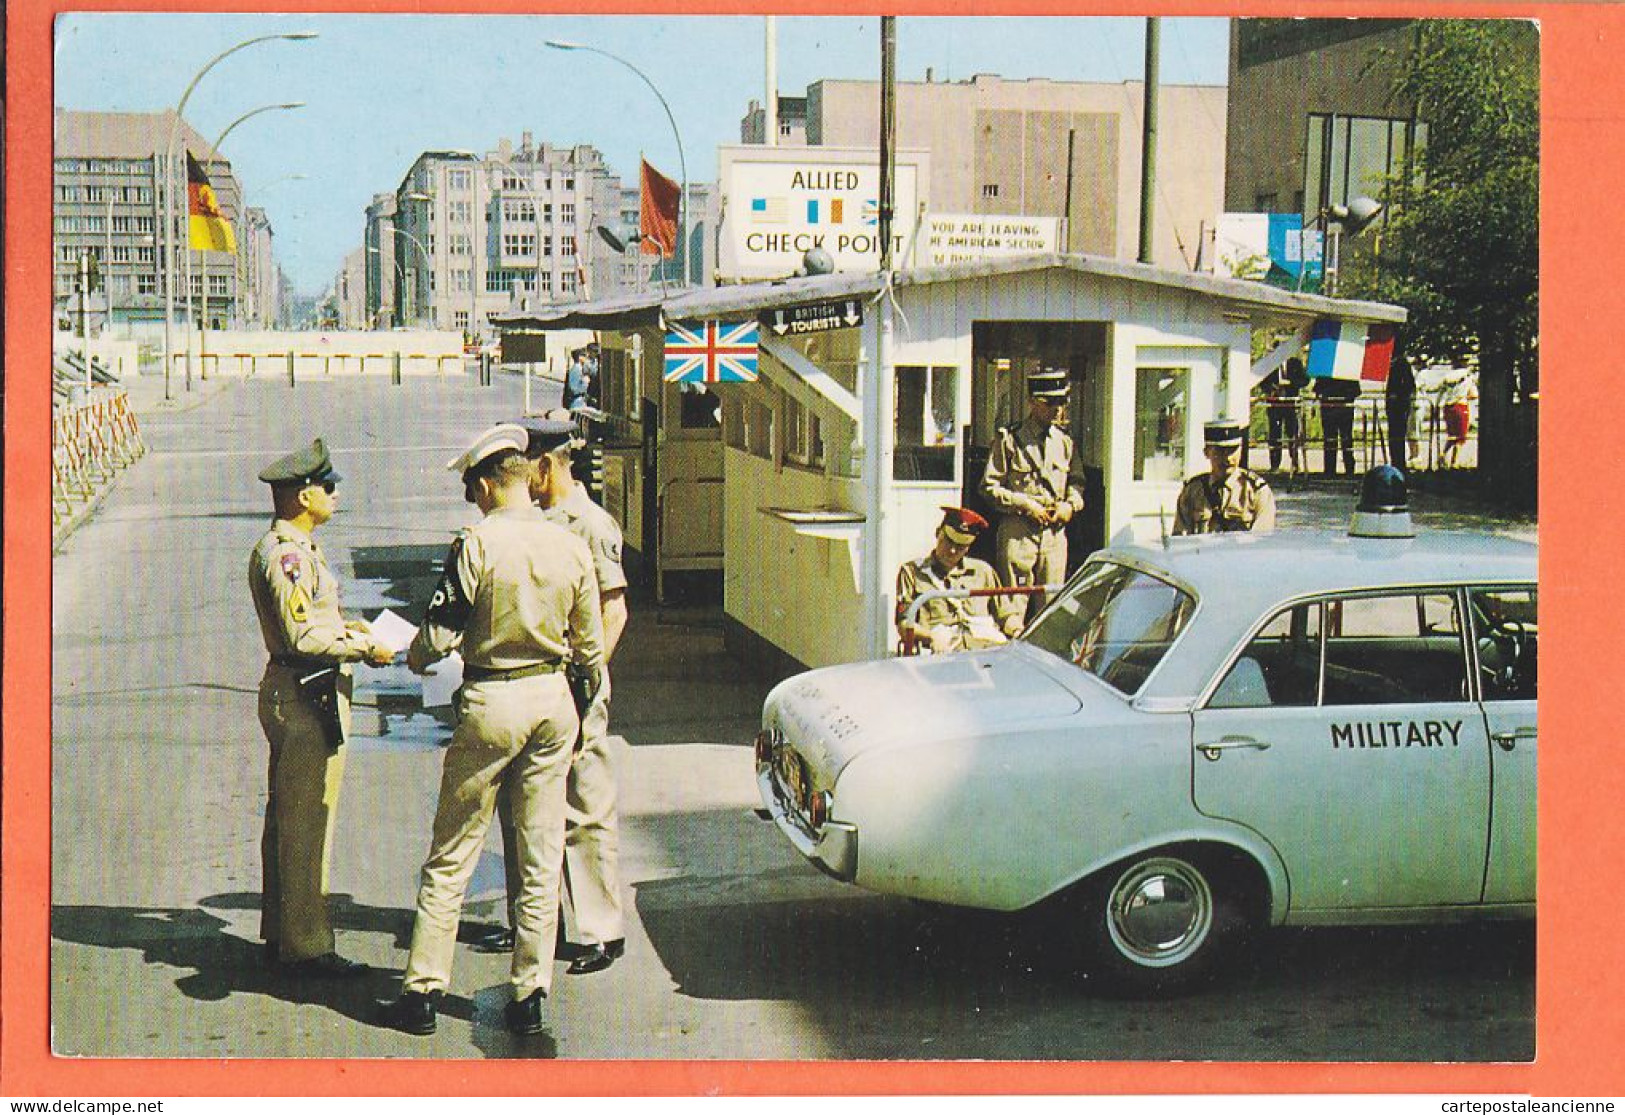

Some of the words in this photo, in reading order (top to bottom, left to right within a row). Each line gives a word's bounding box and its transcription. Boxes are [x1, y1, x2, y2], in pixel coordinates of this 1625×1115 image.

[791, 171, 859, 190] ALLIED
[932, 222, 955, 233] YOU
[961, 223, 982, 234] ARE
[991, 224, 1039, 235] LEAVING
[746, 233, 825, 253] CHECK
[838, 235, 904, 252] POIT
[948, 237, 1001, 249] AMERICAN
[1005, 239, 1045, 250] SECTOR
[795, 305, 835, 319] BRITISH
[791, 316, 840, 333] TOURISTS
[1331, 720, 1463, 748] MILITARY
